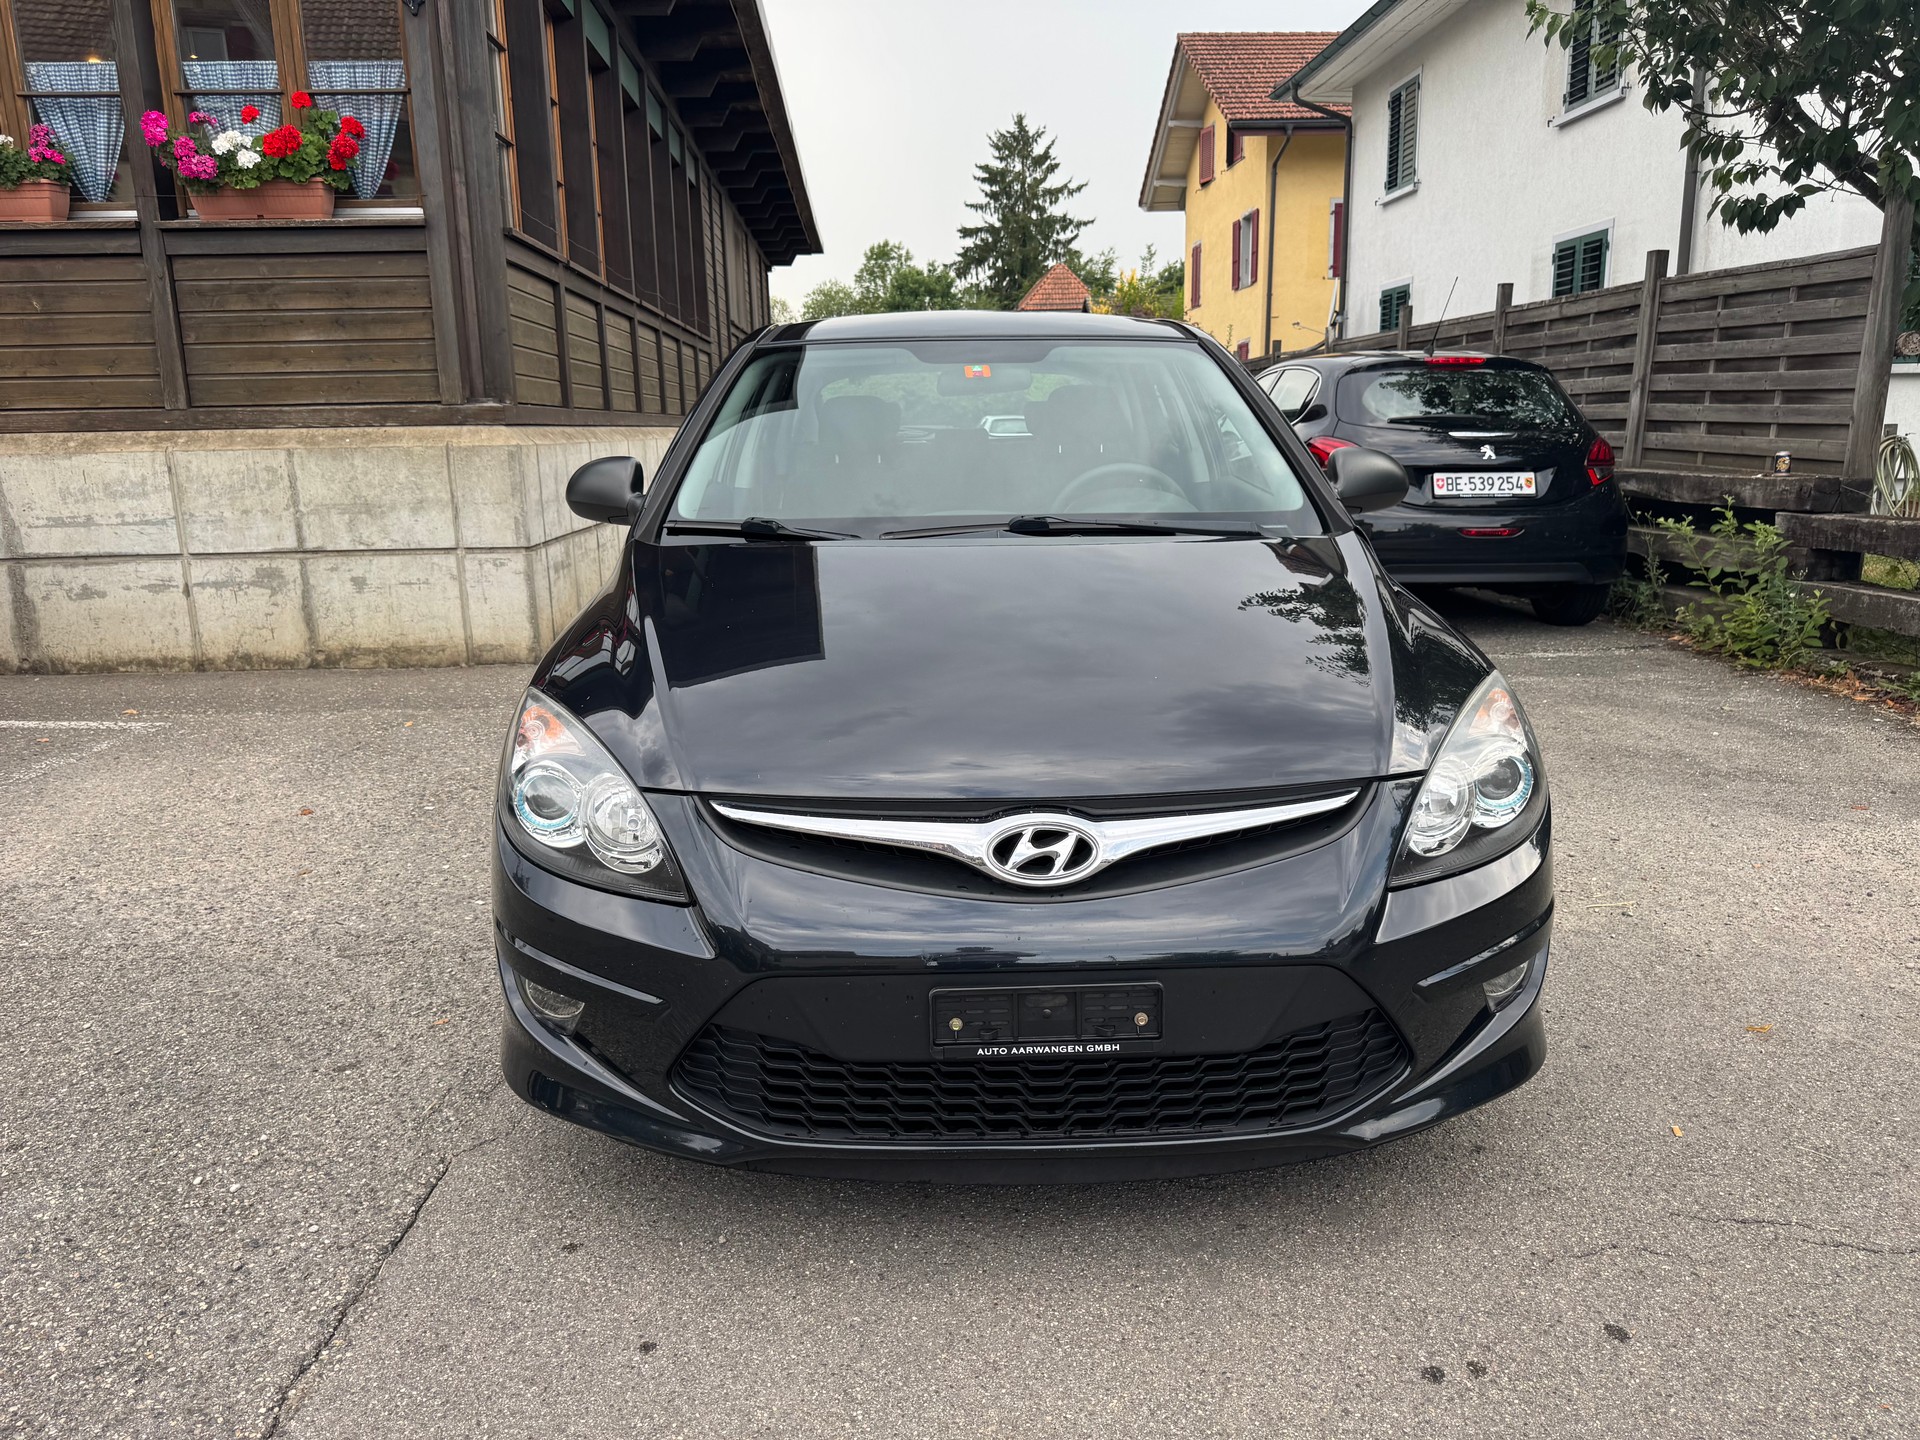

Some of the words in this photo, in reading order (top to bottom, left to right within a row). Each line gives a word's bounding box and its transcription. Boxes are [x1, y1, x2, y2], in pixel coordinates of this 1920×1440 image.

[977, 1047, 1008, 1056] AUTO
[1011, 1045, 1083, 1055] AARWANGEN
[1086, 1043, 1120, 1052] GMBH
